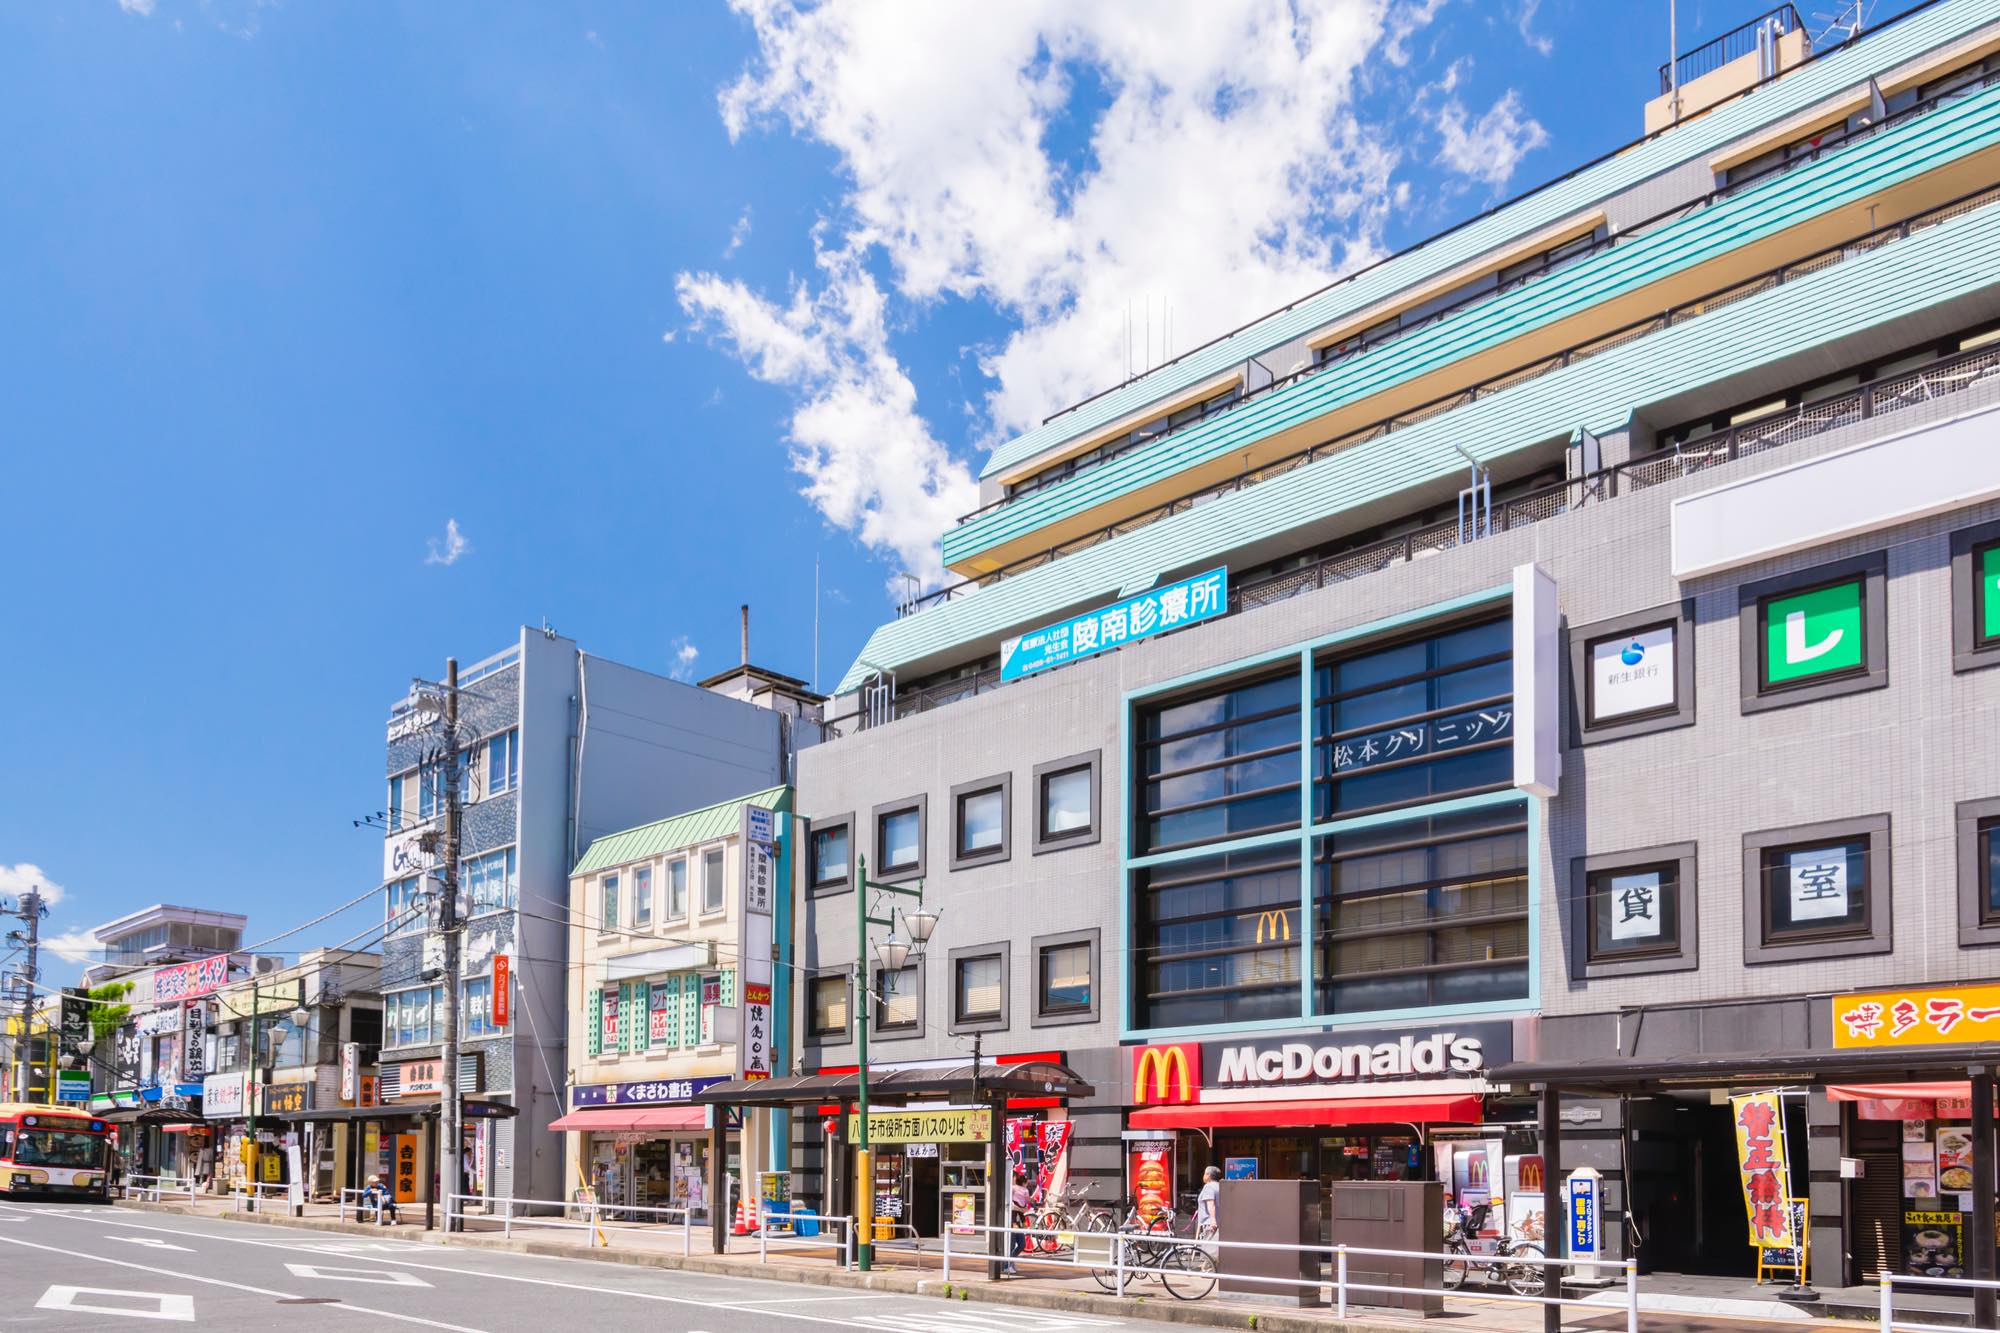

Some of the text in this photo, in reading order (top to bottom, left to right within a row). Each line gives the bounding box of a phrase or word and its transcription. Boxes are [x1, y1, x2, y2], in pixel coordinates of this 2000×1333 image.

[1073, 574, 1221, 654] 陵南診療所
[1022, 626, 1069, 651] 医療法人社団
[1608, 663, 1660, 686] 新生銀行
[1333, 711, 1512, 768] 松本クリニック
[757, 852, 767, 909] 陵南診療所
[1618, 864, 1842, 923] 貸 室
[746, 989, 769, 1001] とんかつ
[1217, 1033, 1484, 1083] McDonald's
[409, 1063, 434, 1082] 吉野家
[626, 1081, 693, 1101] くまざわ書店
[852, 1115, 966, 1139] 八子市役所方面バスのりば
[909, 1146, 937, 1157] とんかつ
[400, 1144, 413, 1193] 吉野家
